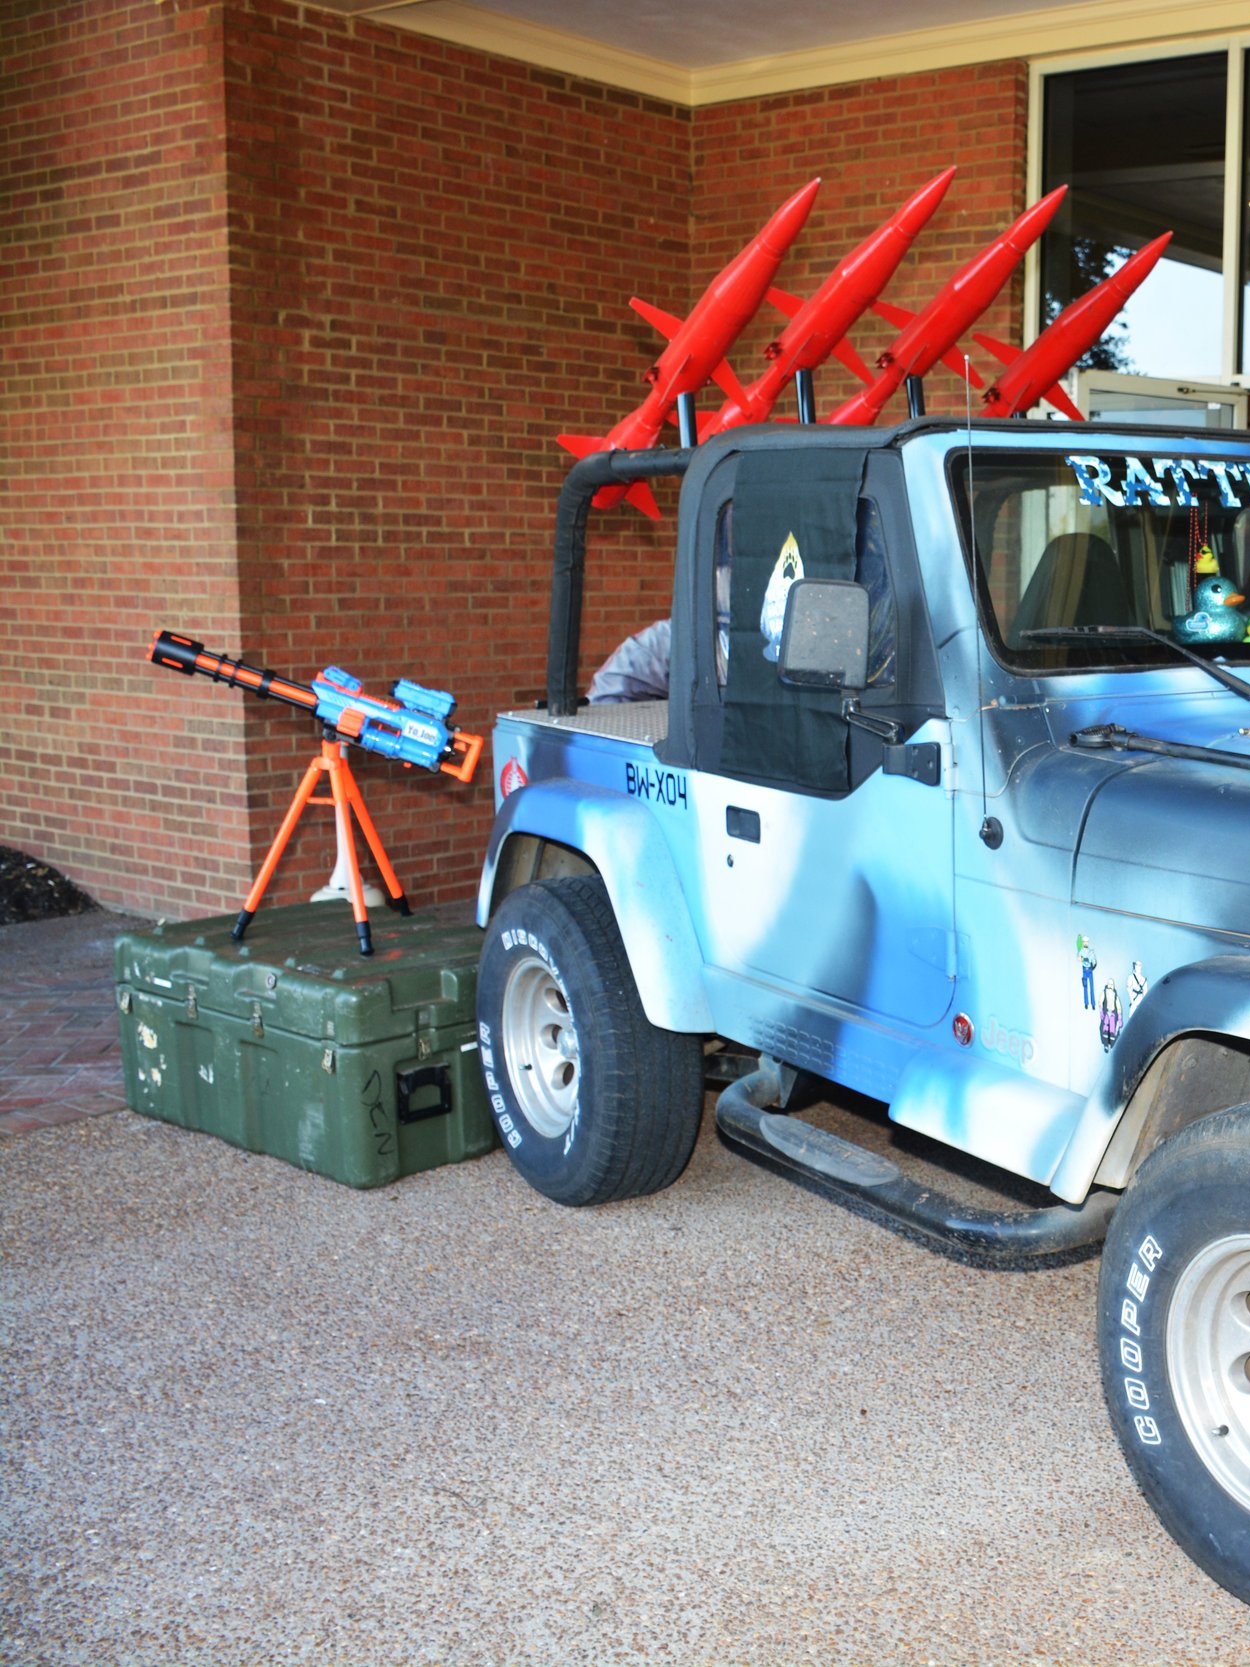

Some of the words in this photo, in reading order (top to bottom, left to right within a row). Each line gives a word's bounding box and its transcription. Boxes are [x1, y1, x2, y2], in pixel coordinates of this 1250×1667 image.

[625, 762, 688, 810] BW-X04
[479, 1021, 523, 1149] COOPER
[1119, 1235, 1164, 1446] COOPER
